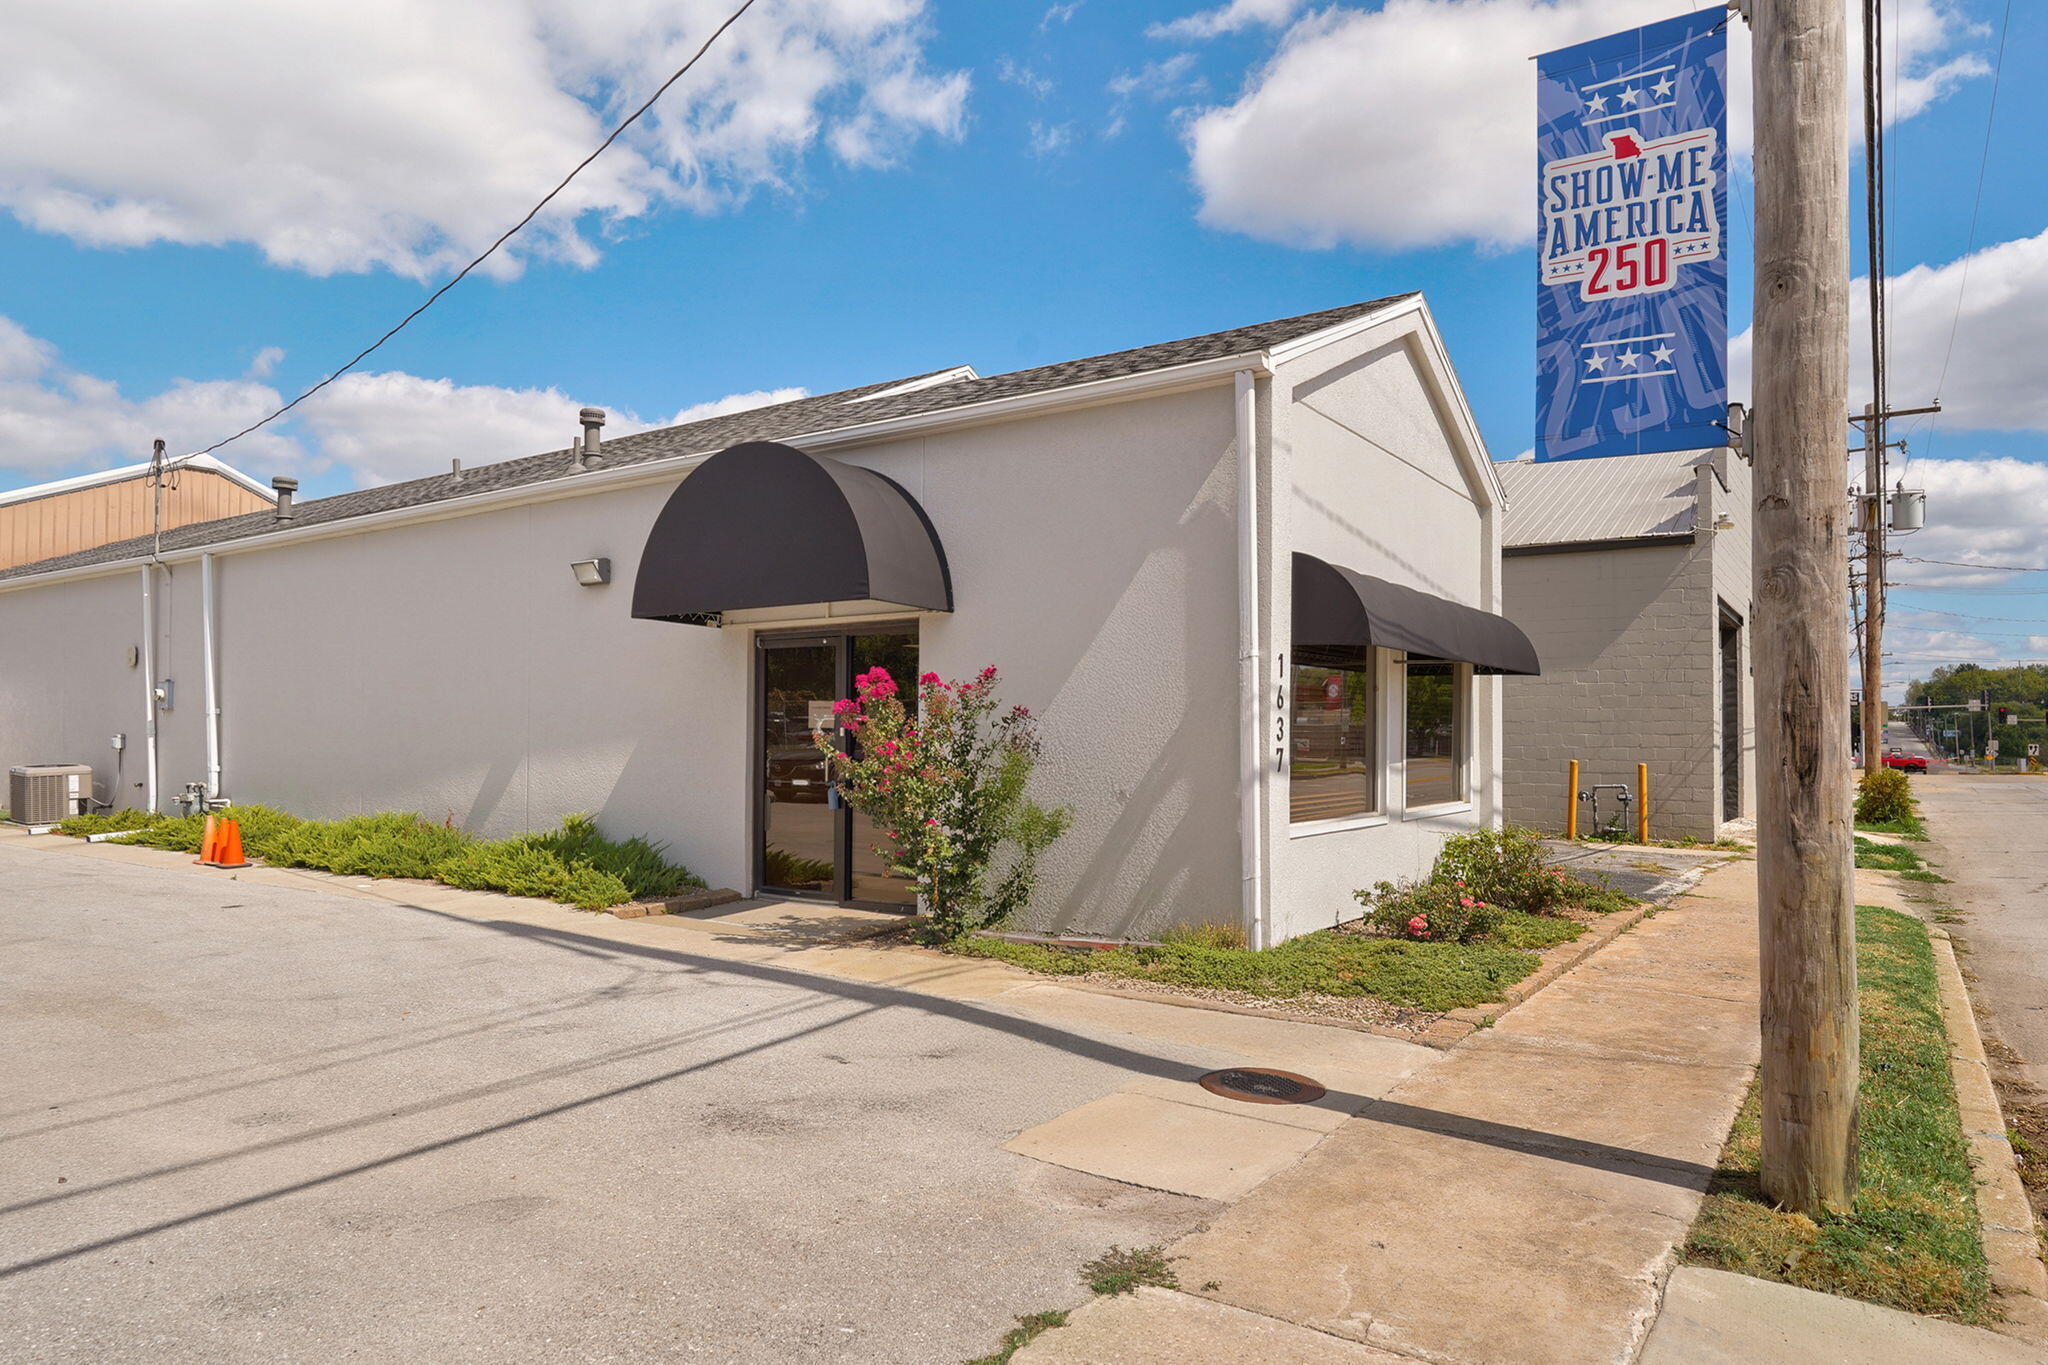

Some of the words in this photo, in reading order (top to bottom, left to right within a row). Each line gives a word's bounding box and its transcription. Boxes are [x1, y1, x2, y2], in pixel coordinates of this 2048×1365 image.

[1550, 145, 1706, 213] SHOW-ME
[1548, 190, 1710, 260] AMERICA
[1587, 237, 1668, 295] 250
[1276, 653, 1284, 773] 1637
